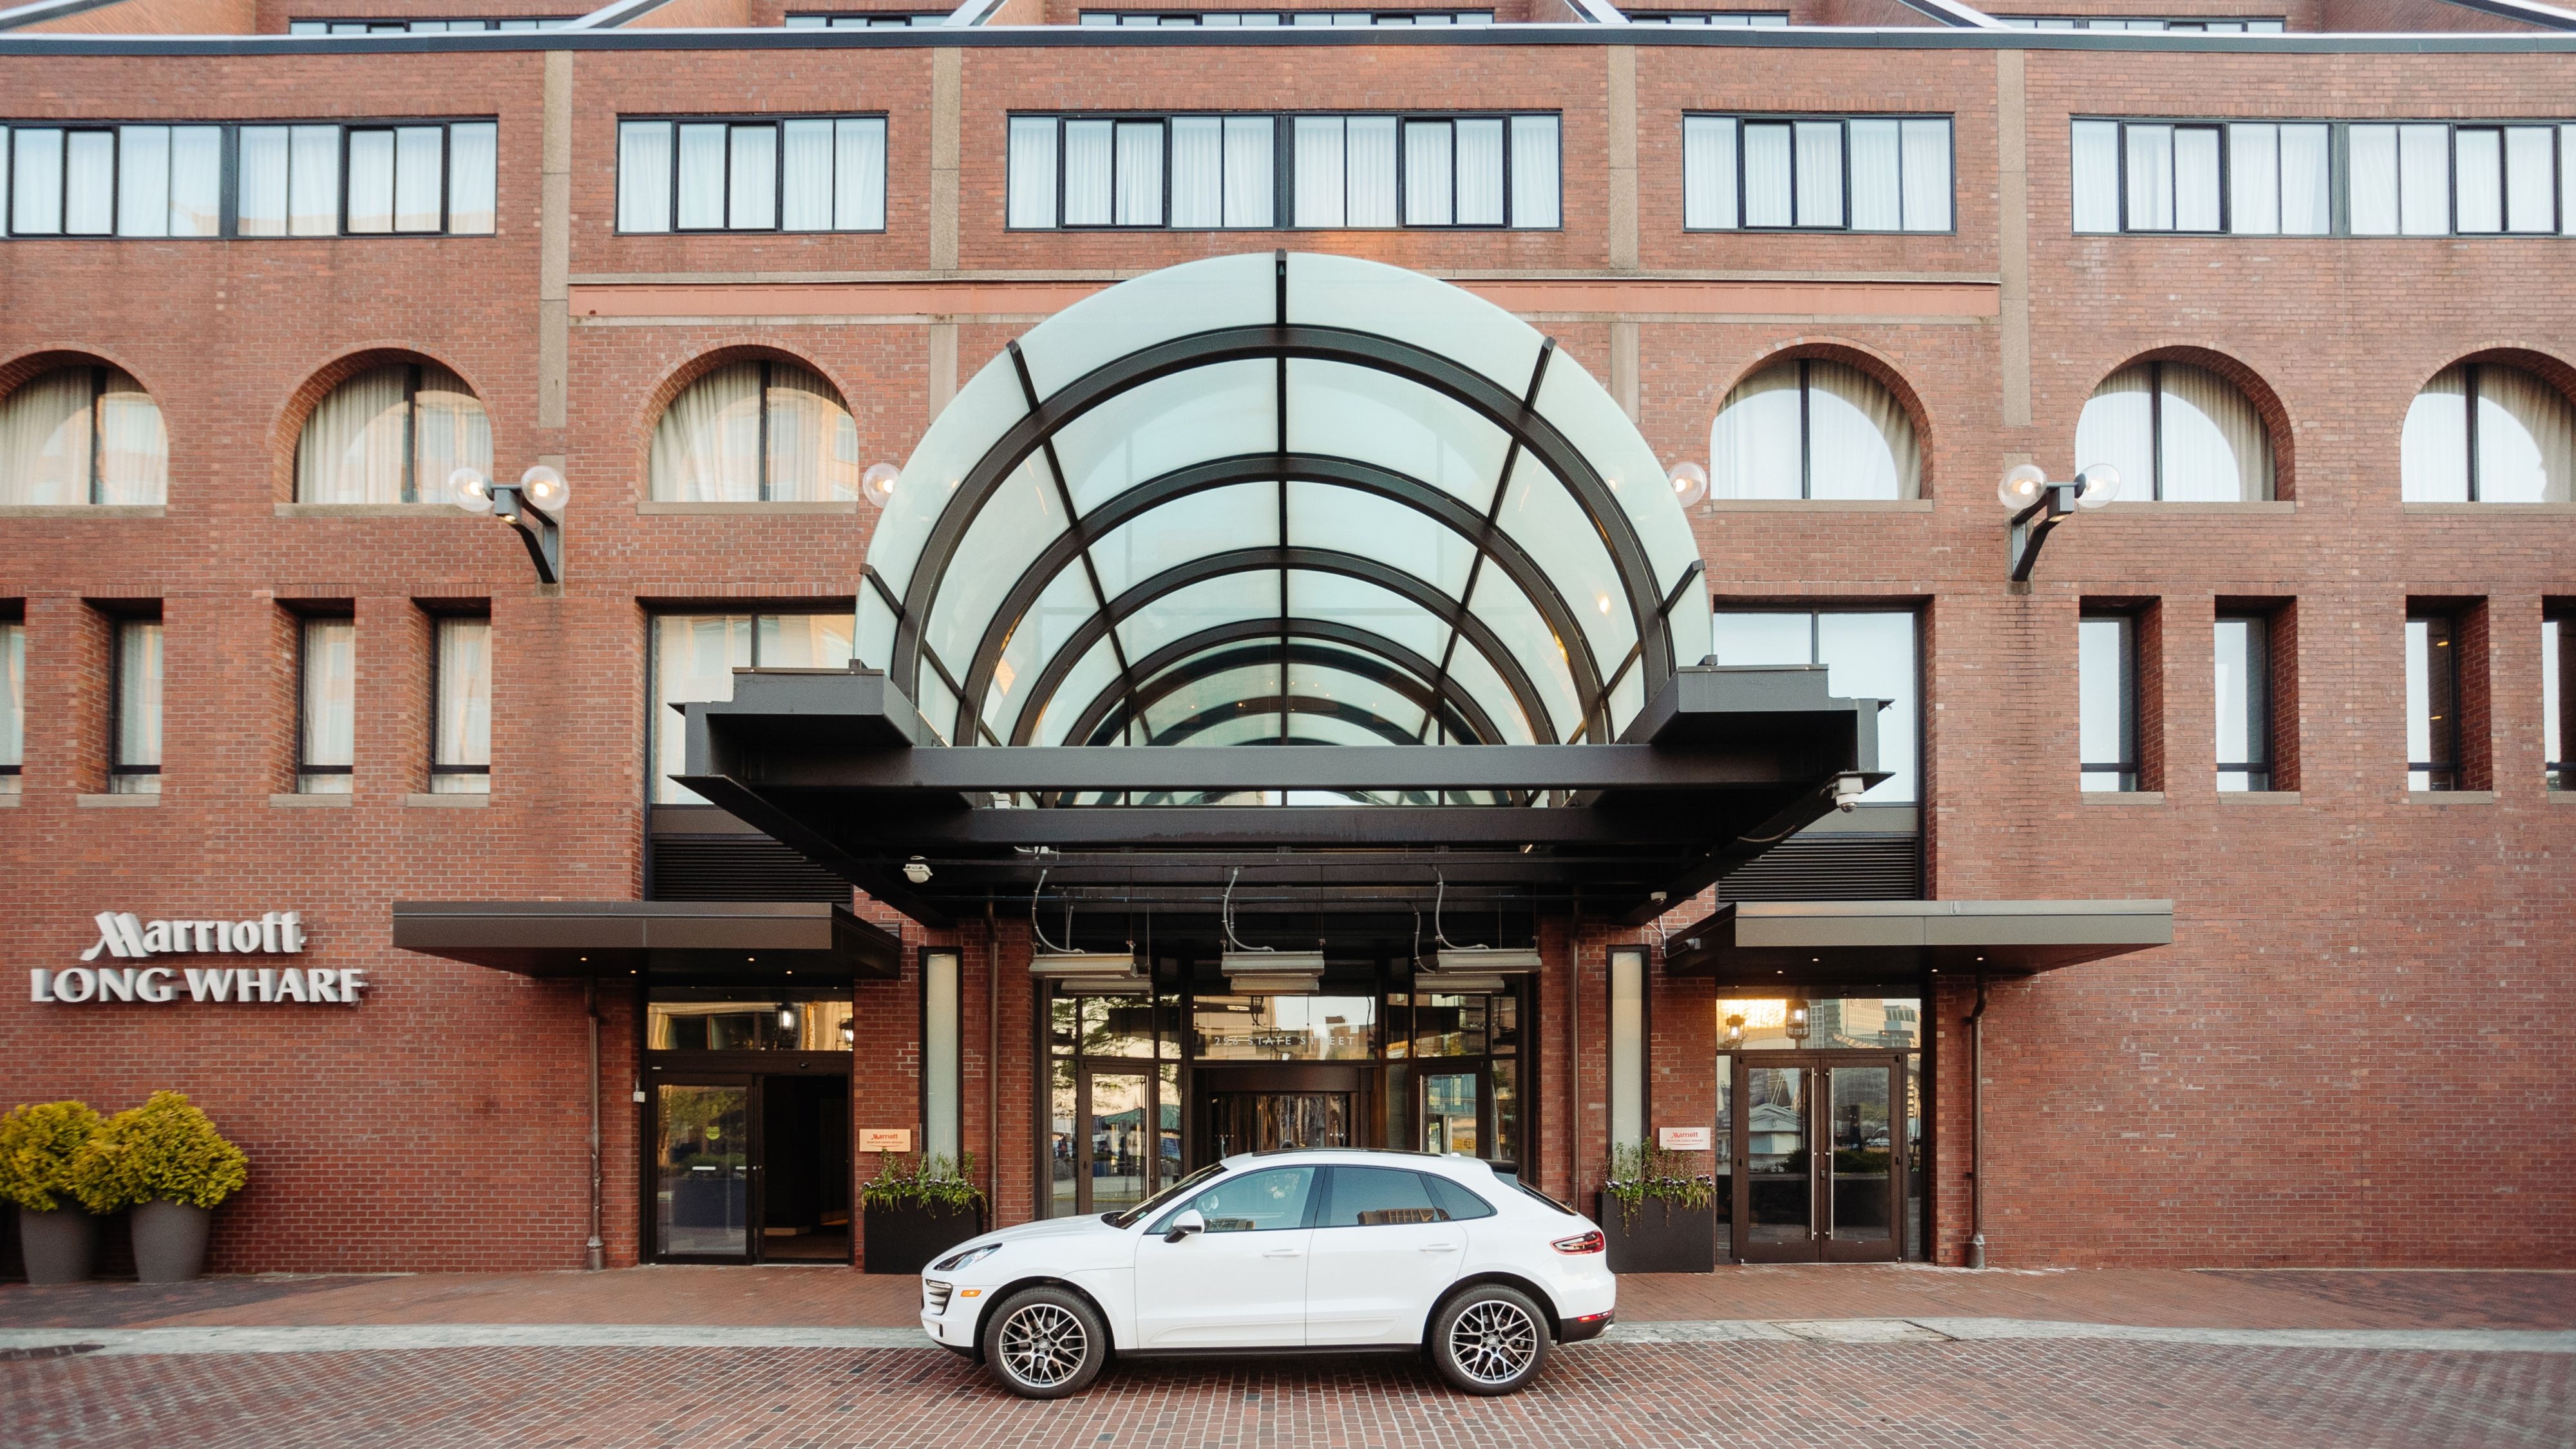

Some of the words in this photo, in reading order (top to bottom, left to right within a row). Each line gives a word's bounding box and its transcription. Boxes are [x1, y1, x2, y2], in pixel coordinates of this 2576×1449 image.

[79, 911, 303, 961] Marriott
[30, 967, 180, 1003] LONG
[184, 967, 367, 1003] WHARF
[1214, 1036, 1239, 1046] 296
[1247, 1036, 1292, 1046] STATE
[1300, 1036, 1354, 1046] STEET
